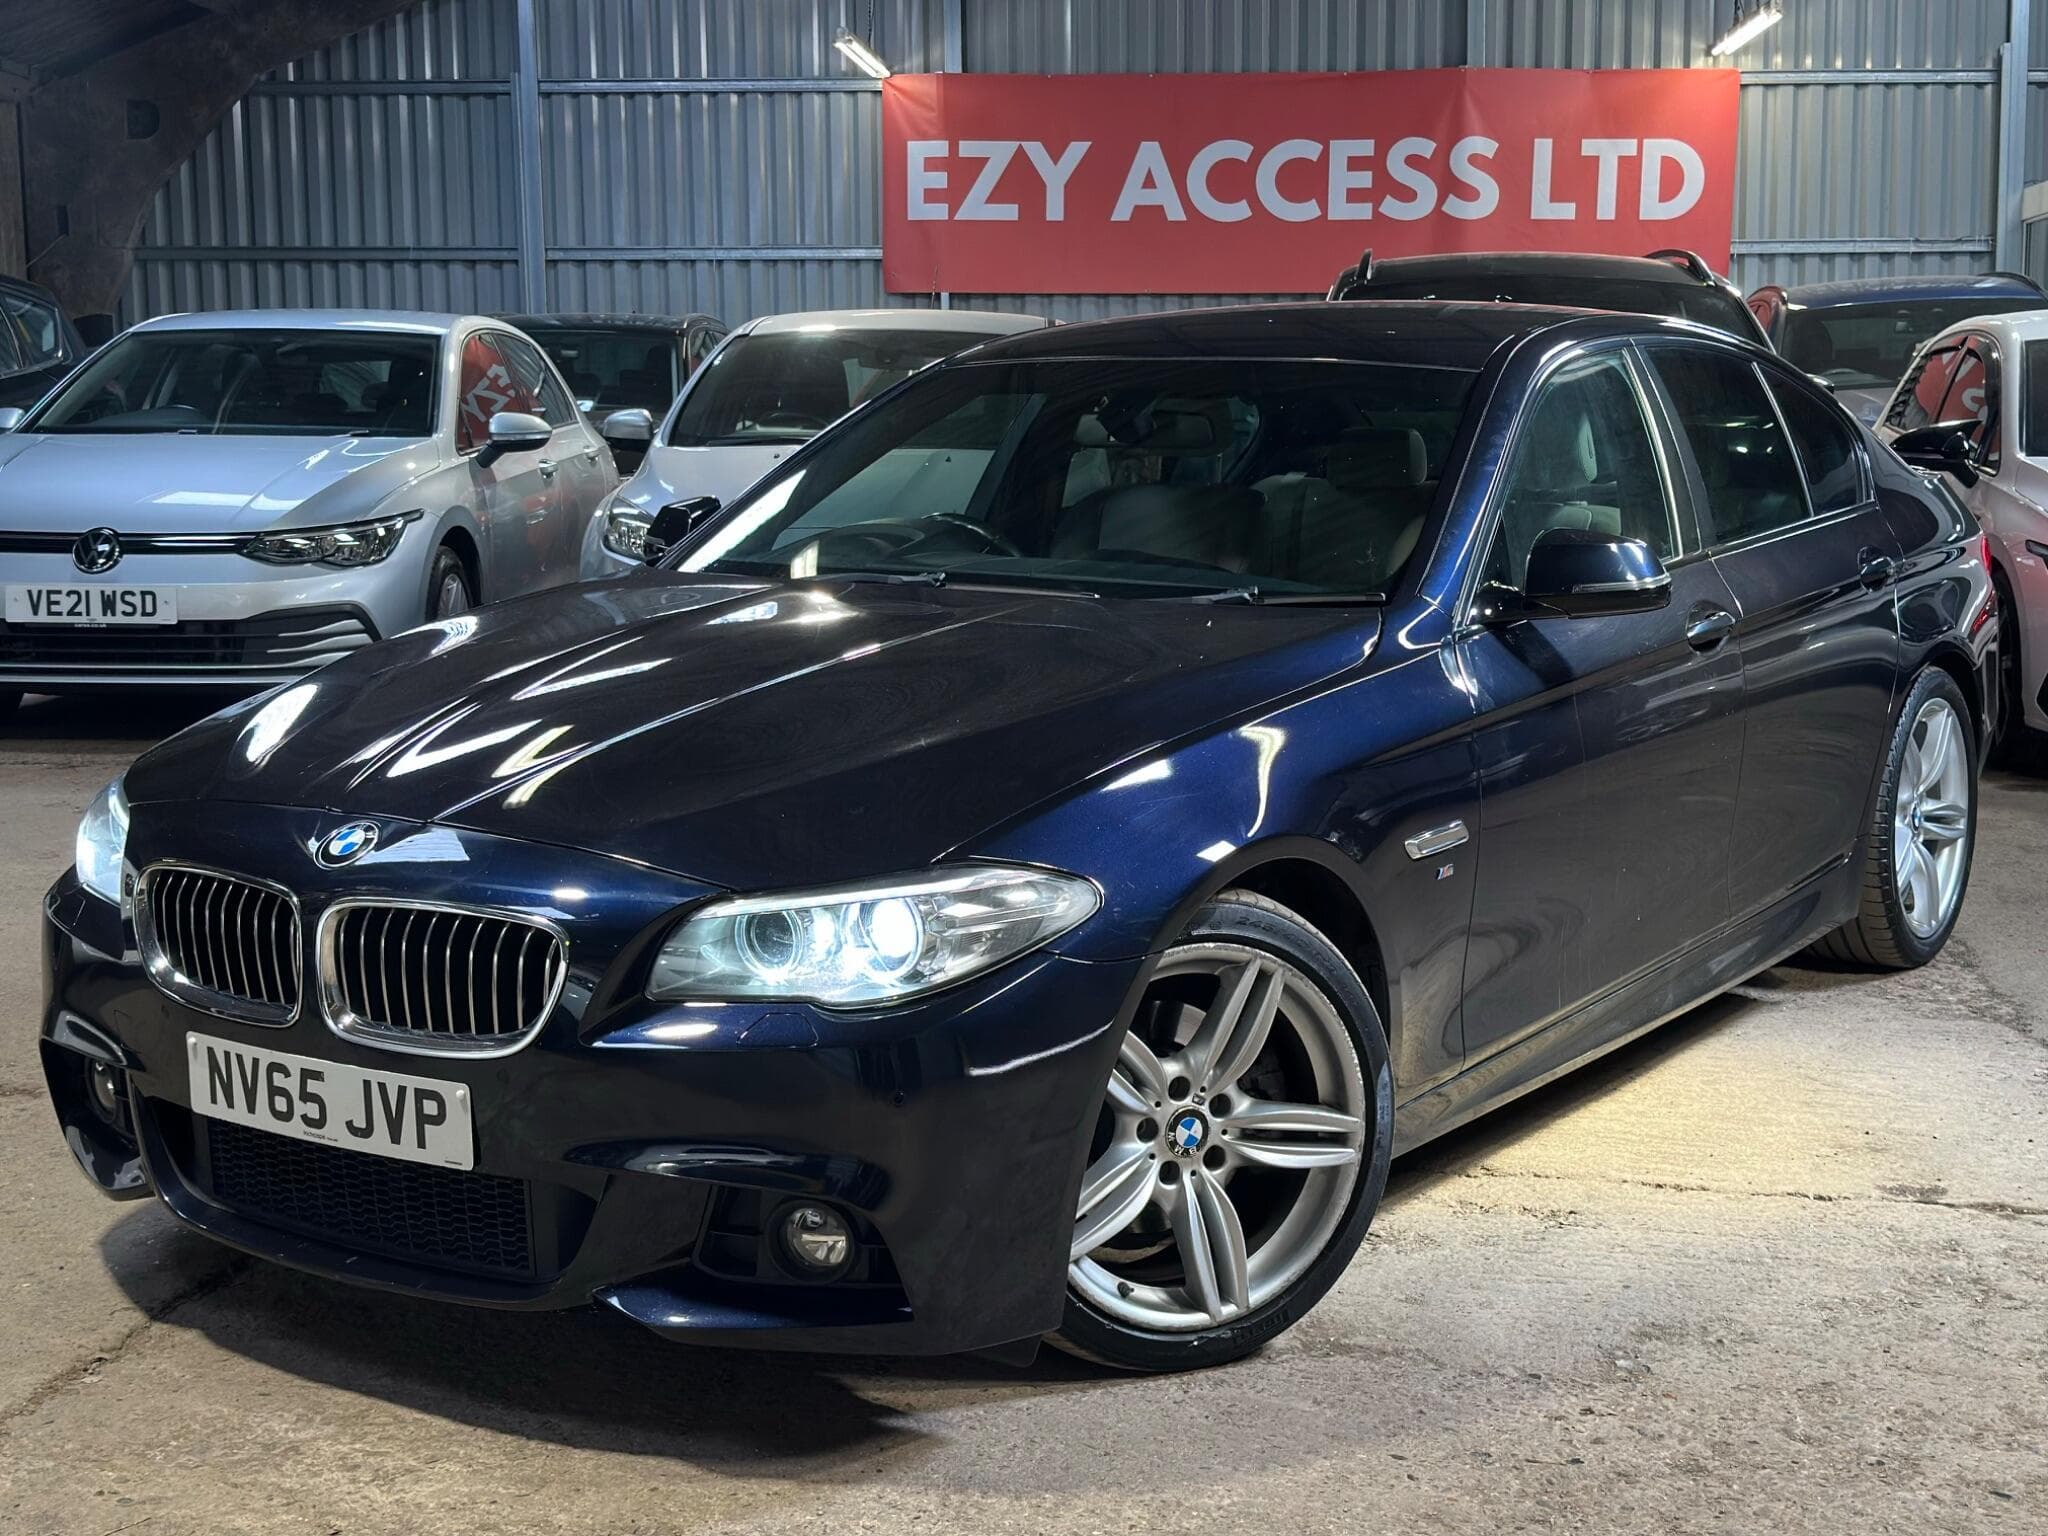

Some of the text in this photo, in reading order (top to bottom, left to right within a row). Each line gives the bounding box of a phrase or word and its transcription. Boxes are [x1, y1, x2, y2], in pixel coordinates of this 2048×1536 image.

[907, 136, 1705, 222] EZY ACCESS LTD
[26, 589, 157, 617] VE21 WSD
[206, 1045, 448, 1150] NV65 JVP
